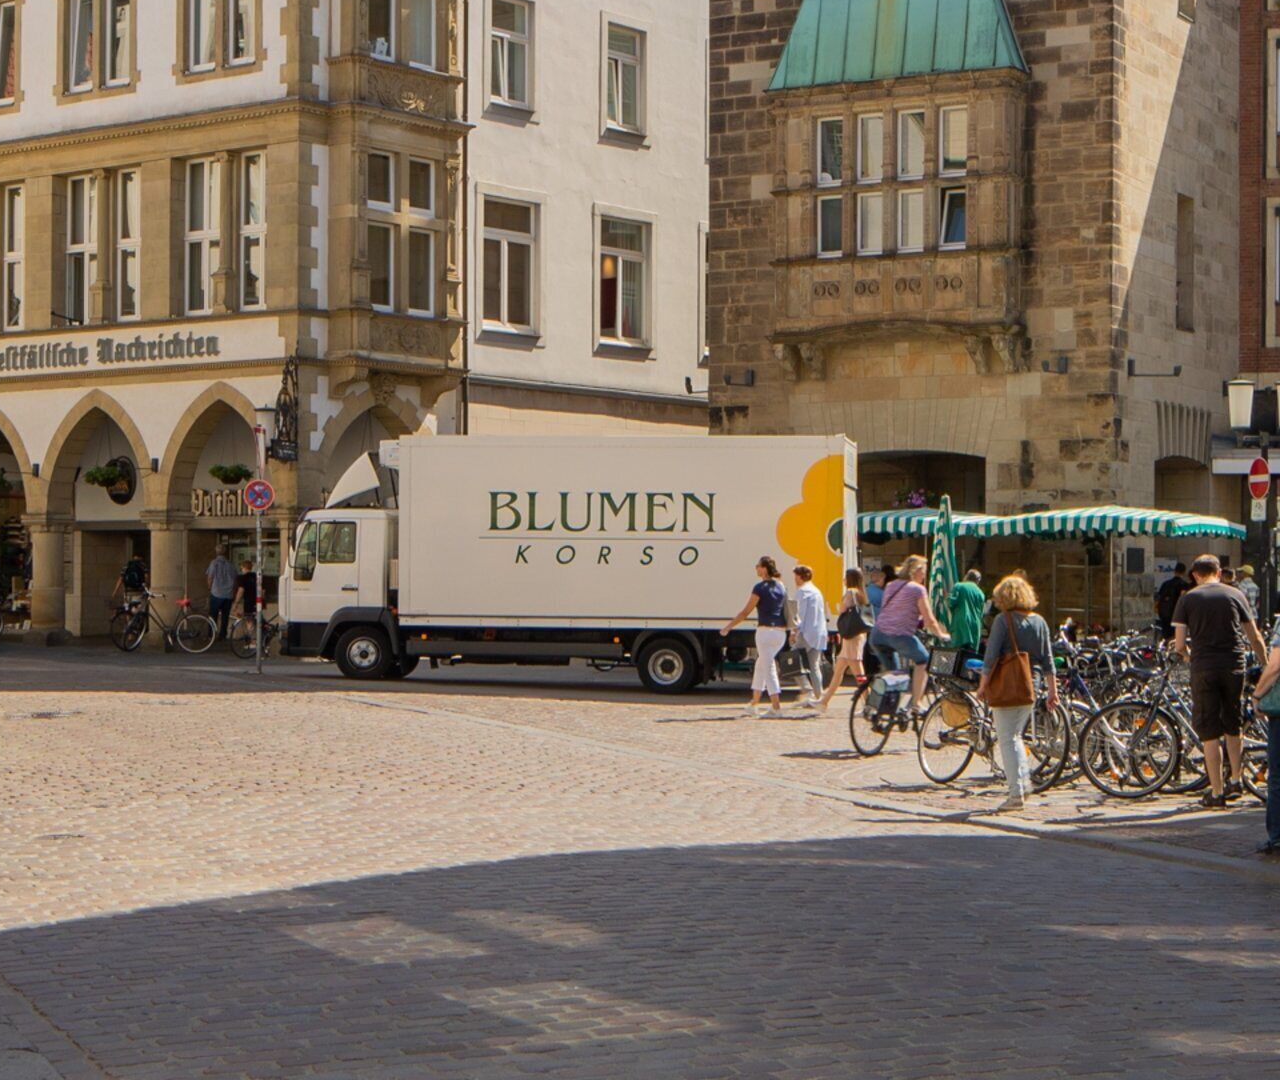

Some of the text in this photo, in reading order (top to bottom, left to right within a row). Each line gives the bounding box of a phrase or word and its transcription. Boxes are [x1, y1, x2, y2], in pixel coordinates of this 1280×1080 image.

[97, 330, 222, 364] Nachrichten
[488, 491, 717, 533] BLUMEN
[515, 544, 700, 567] KORSO
